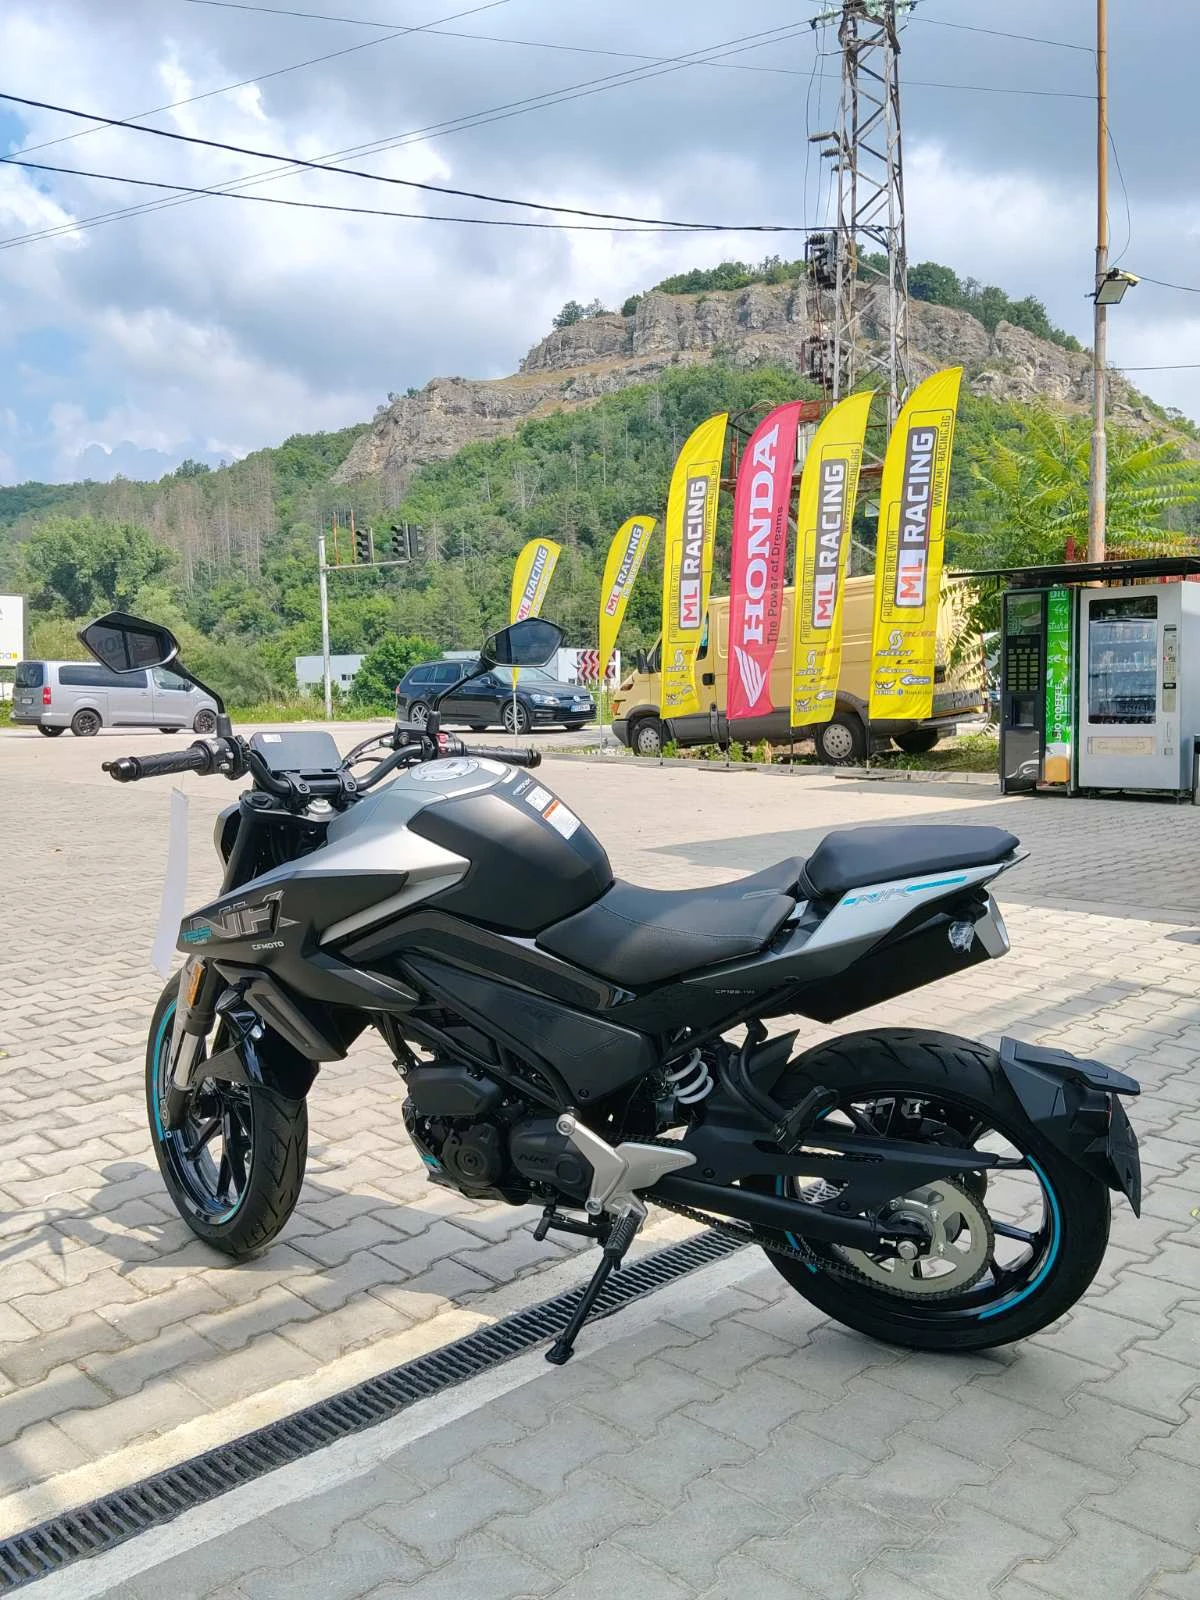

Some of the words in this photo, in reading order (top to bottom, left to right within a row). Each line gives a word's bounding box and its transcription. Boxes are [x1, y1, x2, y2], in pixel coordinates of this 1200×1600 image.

[904, 433, 933, 542] RACING
[683, 480, 706, 574] RACING
[743, 423, 779, 645] HONDA
[771, 506, 782, 556] Dreams
[818, 464, 844, 567] RACING
[525, 547, 548, 600] RACING
[607, 592, 620, 612] ML
[617, 526, 643, 585] RACING
[900, 559, 922, 598] ML
[682, 587, 697, 621] ML
[768, 577, 779, 618] Power
[816, 582, 833, 621] ML
[767, 623, 777, 645] The
[252, 941, 285, 951] CFMOTO
